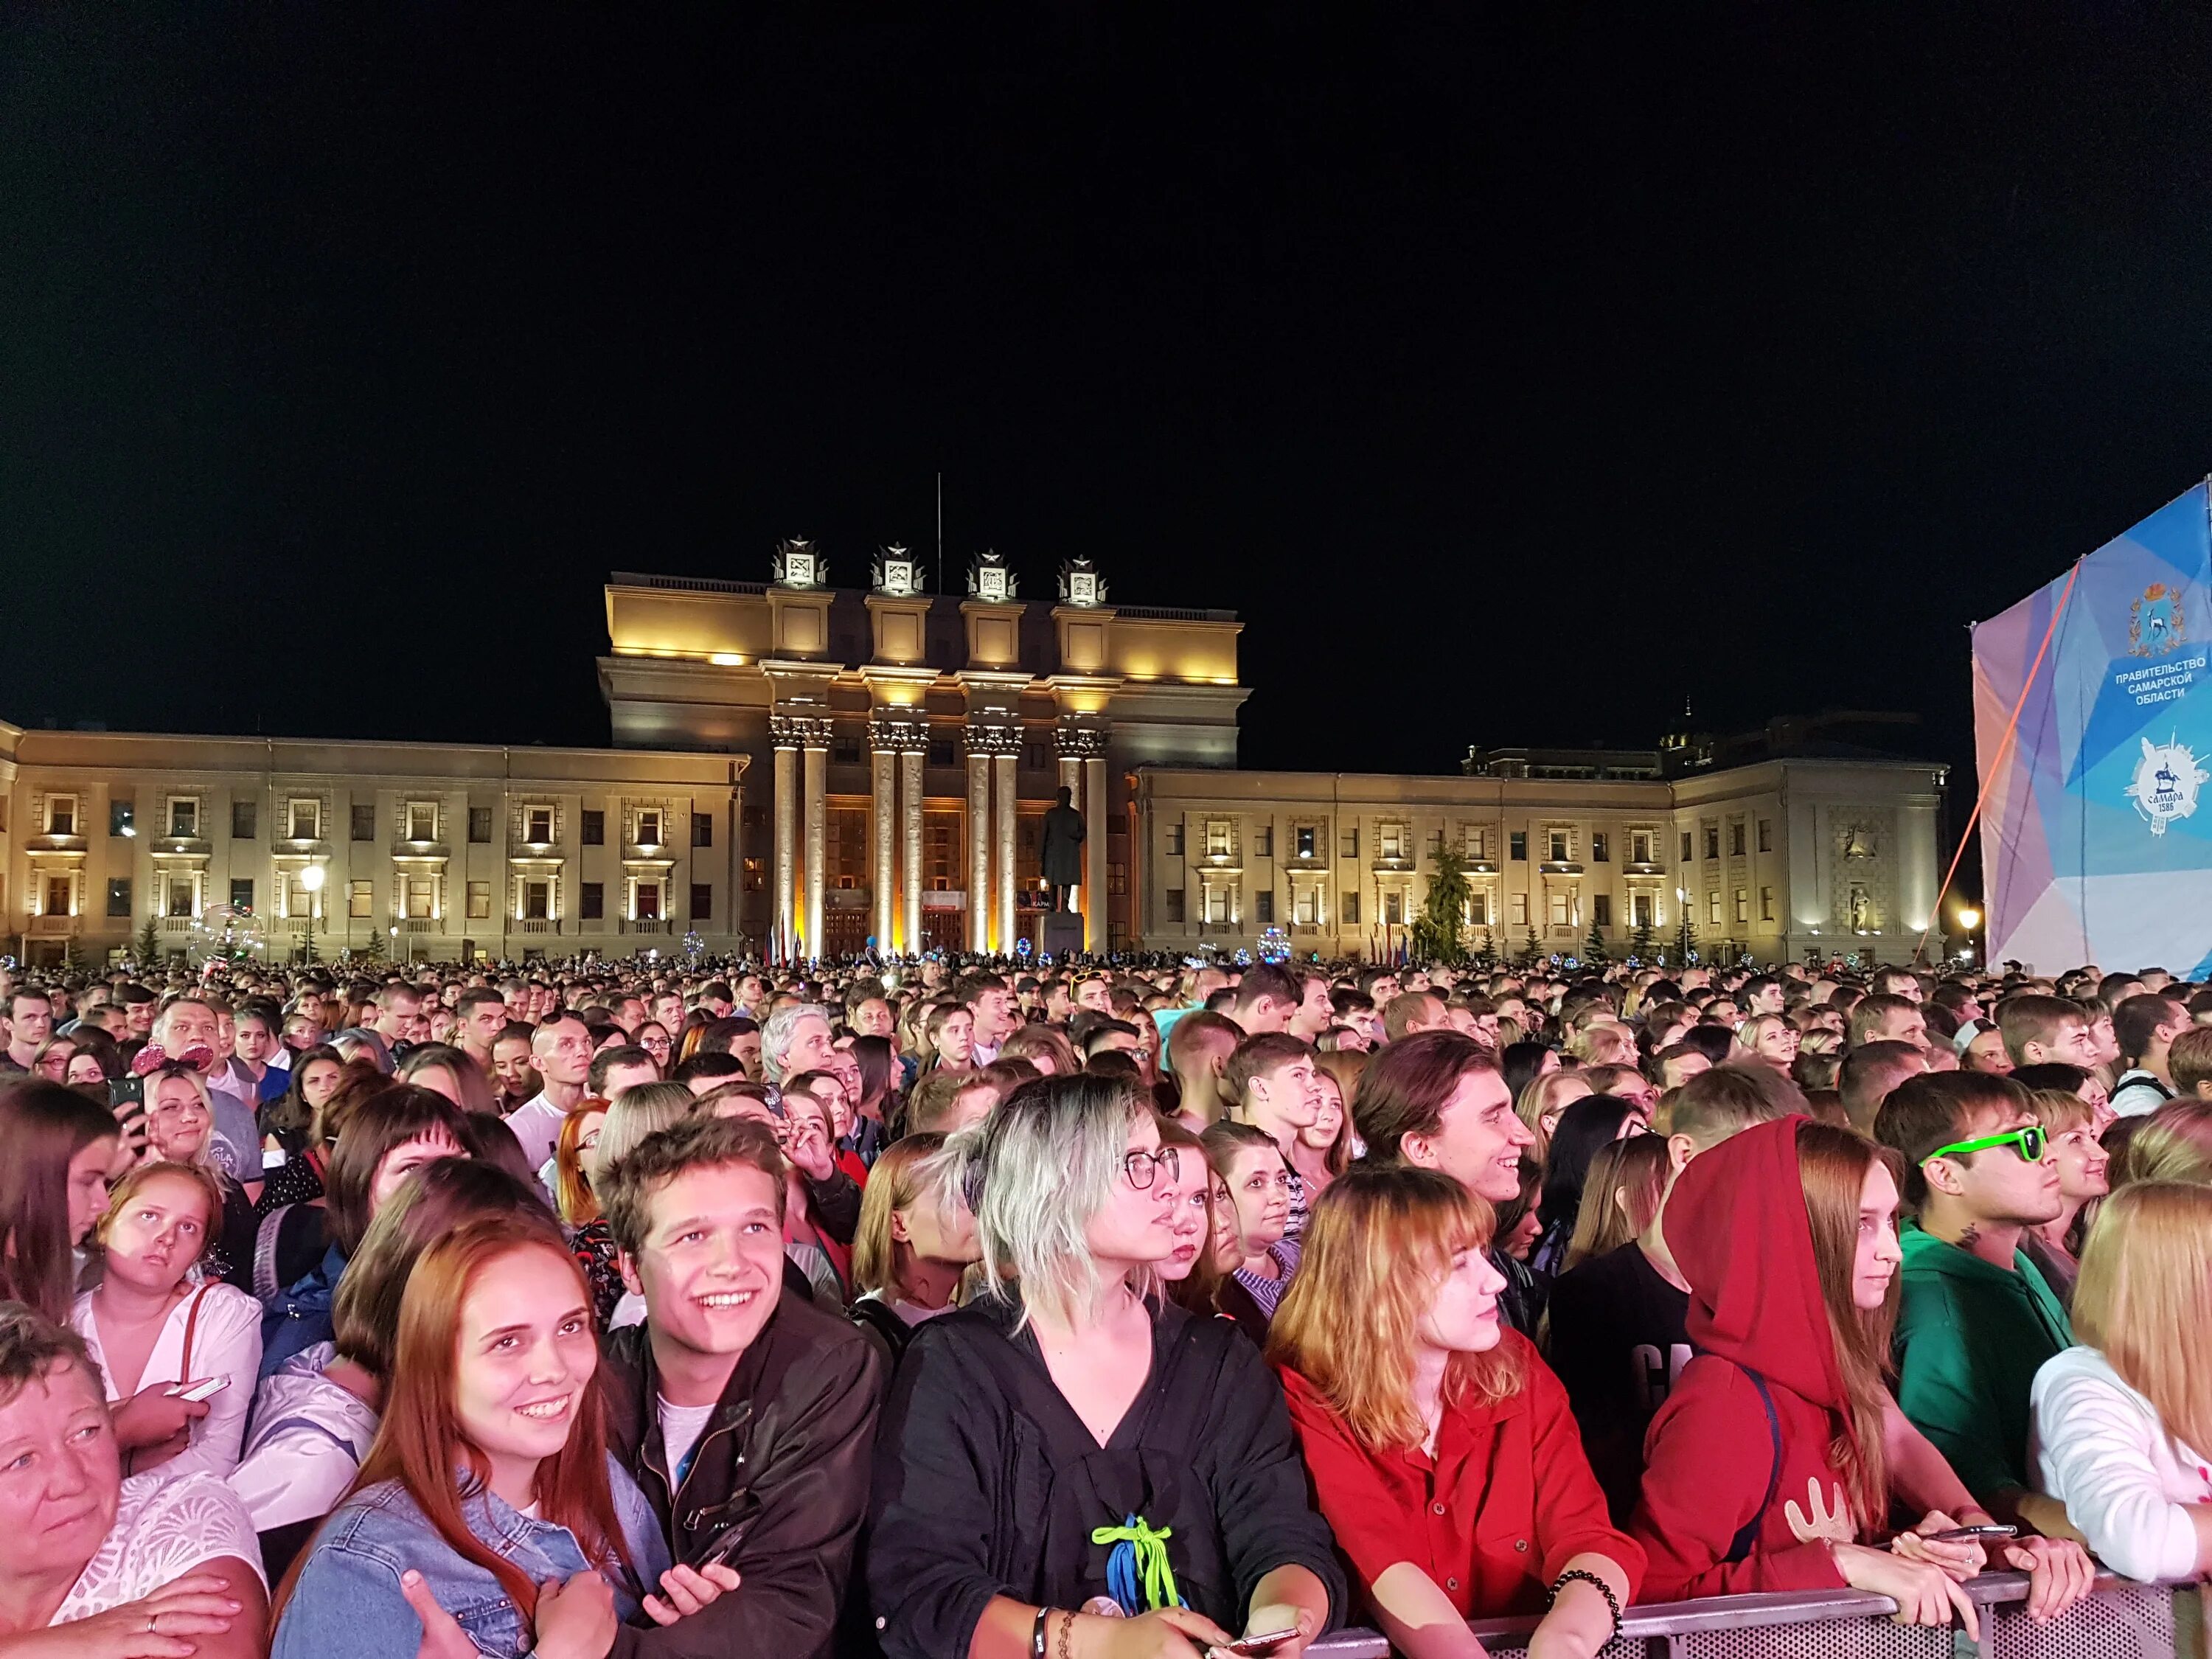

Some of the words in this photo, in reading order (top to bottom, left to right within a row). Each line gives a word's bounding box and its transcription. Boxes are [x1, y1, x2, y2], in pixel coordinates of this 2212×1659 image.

[2115, 657, 2206, 684] ПРАВИТЕЛЬСТВО
[2128, 672, 2193, 695] САМАРСКОЙ
[2135, 688, 2185, 706] ОБЛАСТИ
[2159, 802, 2174, 813] 1586
